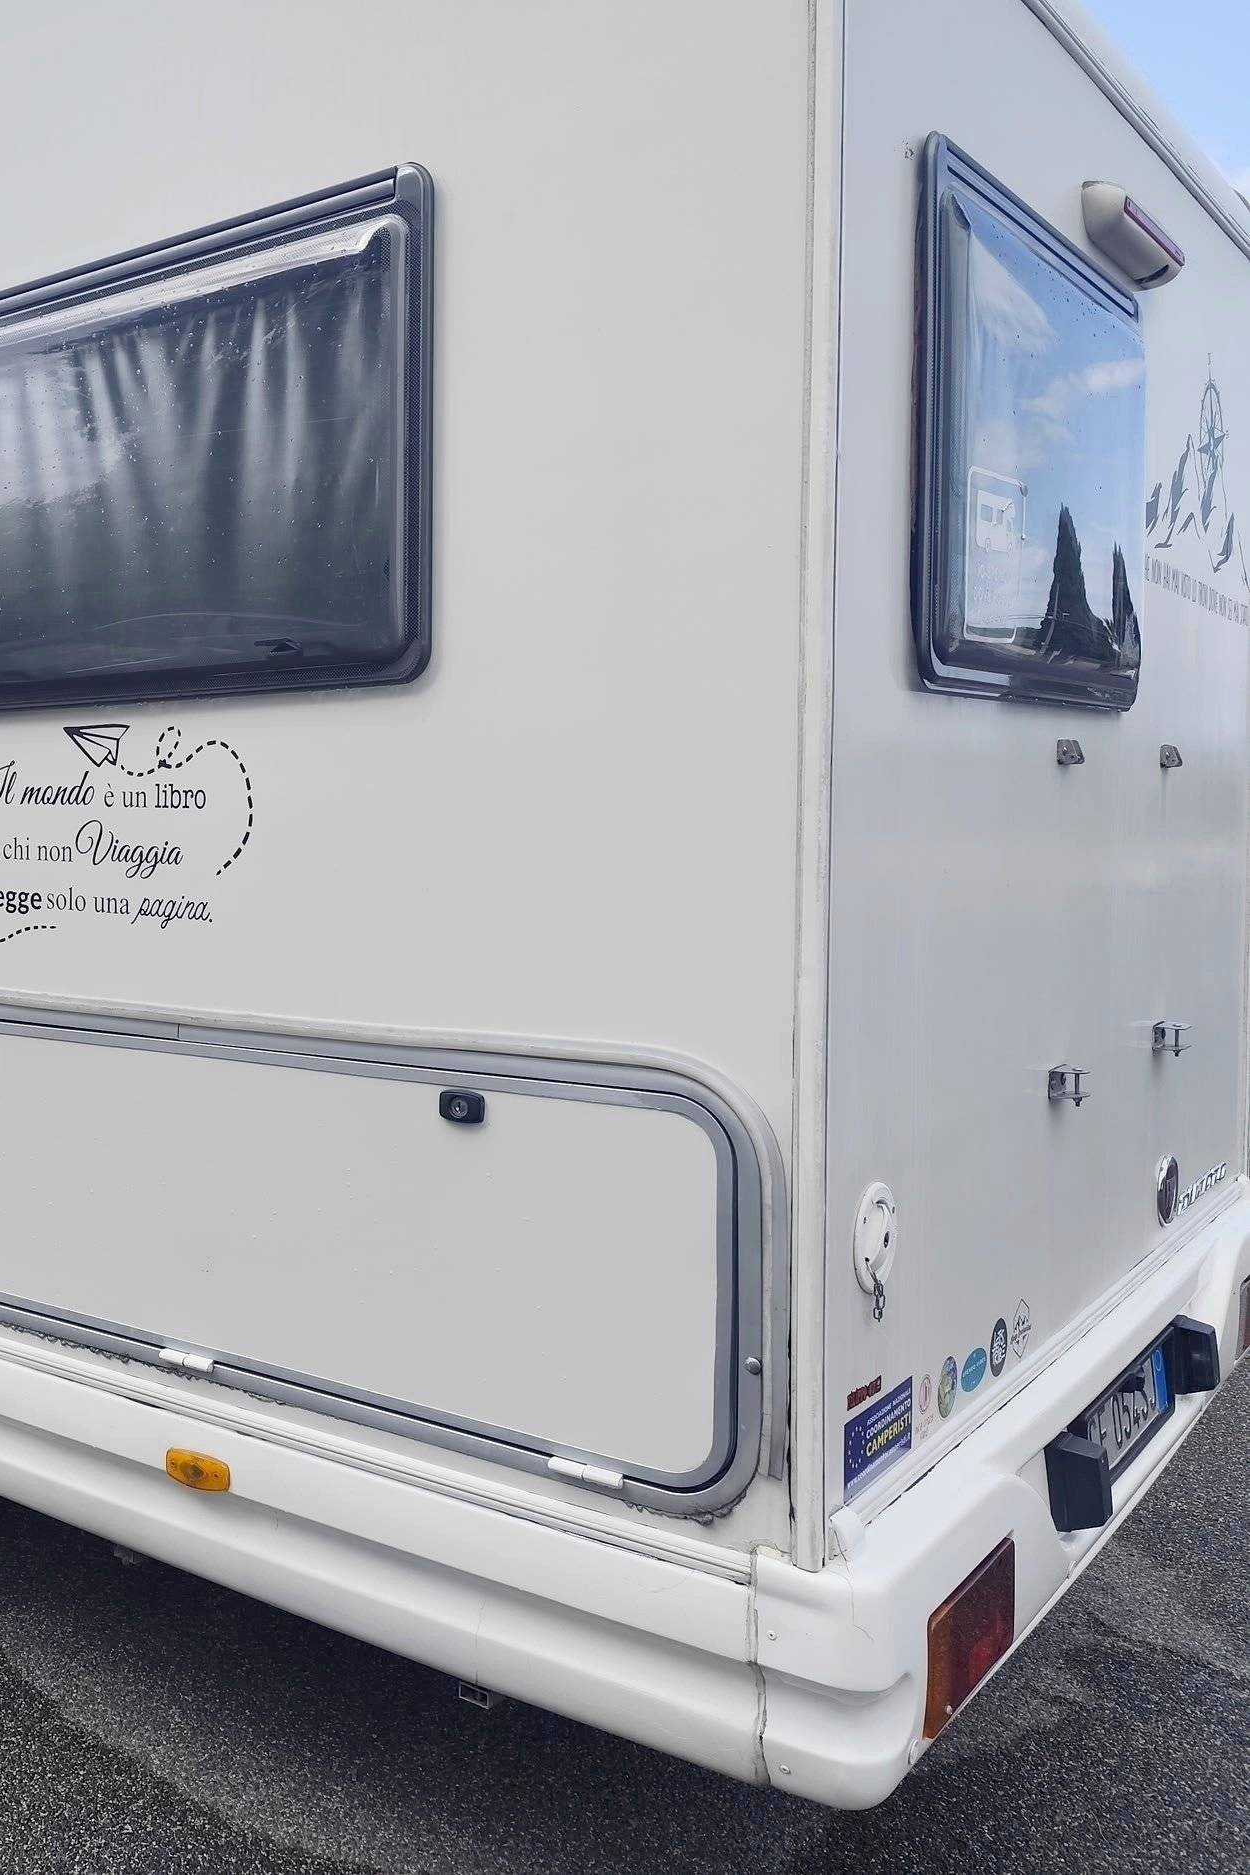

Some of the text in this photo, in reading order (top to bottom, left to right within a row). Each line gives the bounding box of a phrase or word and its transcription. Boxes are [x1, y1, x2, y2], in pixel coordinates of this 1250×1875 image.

[20, 770, 95, 806] mondo
[104, 783, 115, 808] è
[122, 789, 147, 809] un
[155, 784, 207, 810] libro
[3, 837, 31, 861] chi
[38, 843, 73, 863] non
[75, 819, 184, 879] Viaggia
[46, 887, 86, 912] solo
[94, 895, 130, 915] una
[131, 895, 213, 929] pagina.
[865, 1410, 911, 1457] CAMPERISTI
[866, 1398, 911, 1440] COORDINAMENTO
